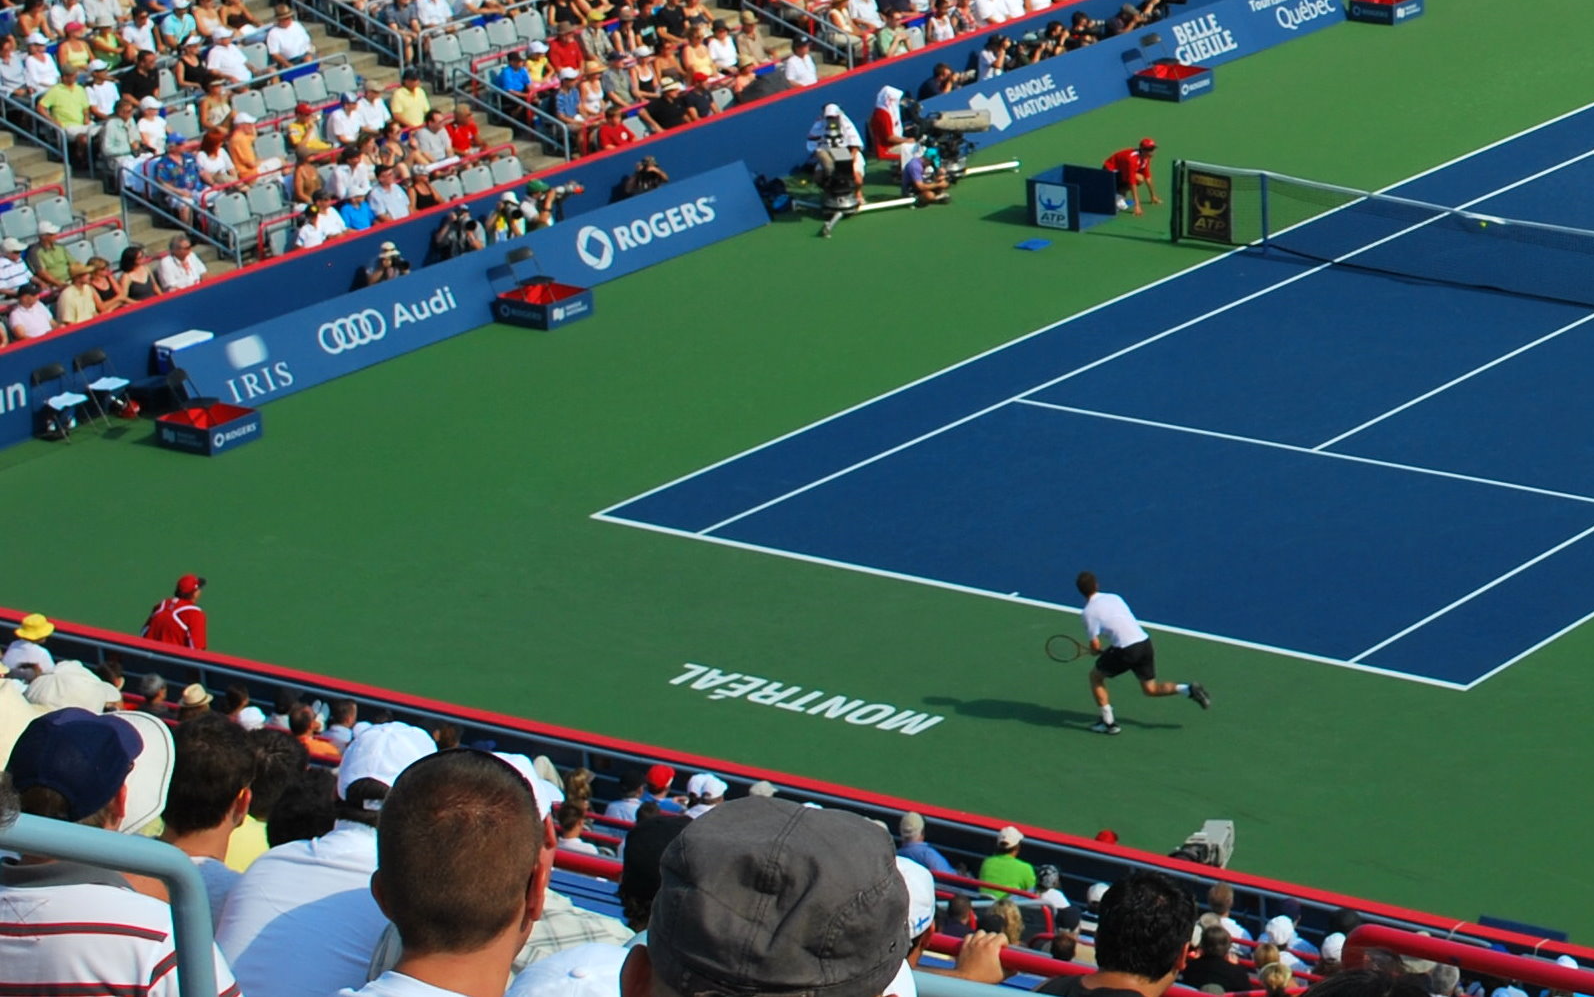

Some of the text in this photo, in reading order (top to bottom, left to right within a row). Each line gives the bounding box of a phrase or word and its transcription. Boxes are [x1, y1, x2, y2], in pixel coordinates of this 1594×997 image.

[1172, 13, 1222, 46] BELLE
[1175, 30, 1238, 67] GUEULE
[1005, 73, 1056, 103] BANQUE
[1012, 85, 1079, 121] NATIONALE
[612, 197, 716, 252] ROGERS
[1040, 212, 1066, 223] ATP
[393, 286, 457, 329] Audi
[226, 361, 294, 404] IRIS
[225, 422, 257, 441] ROGERS
[668, 662, 945, 736] MONTRÉAL
